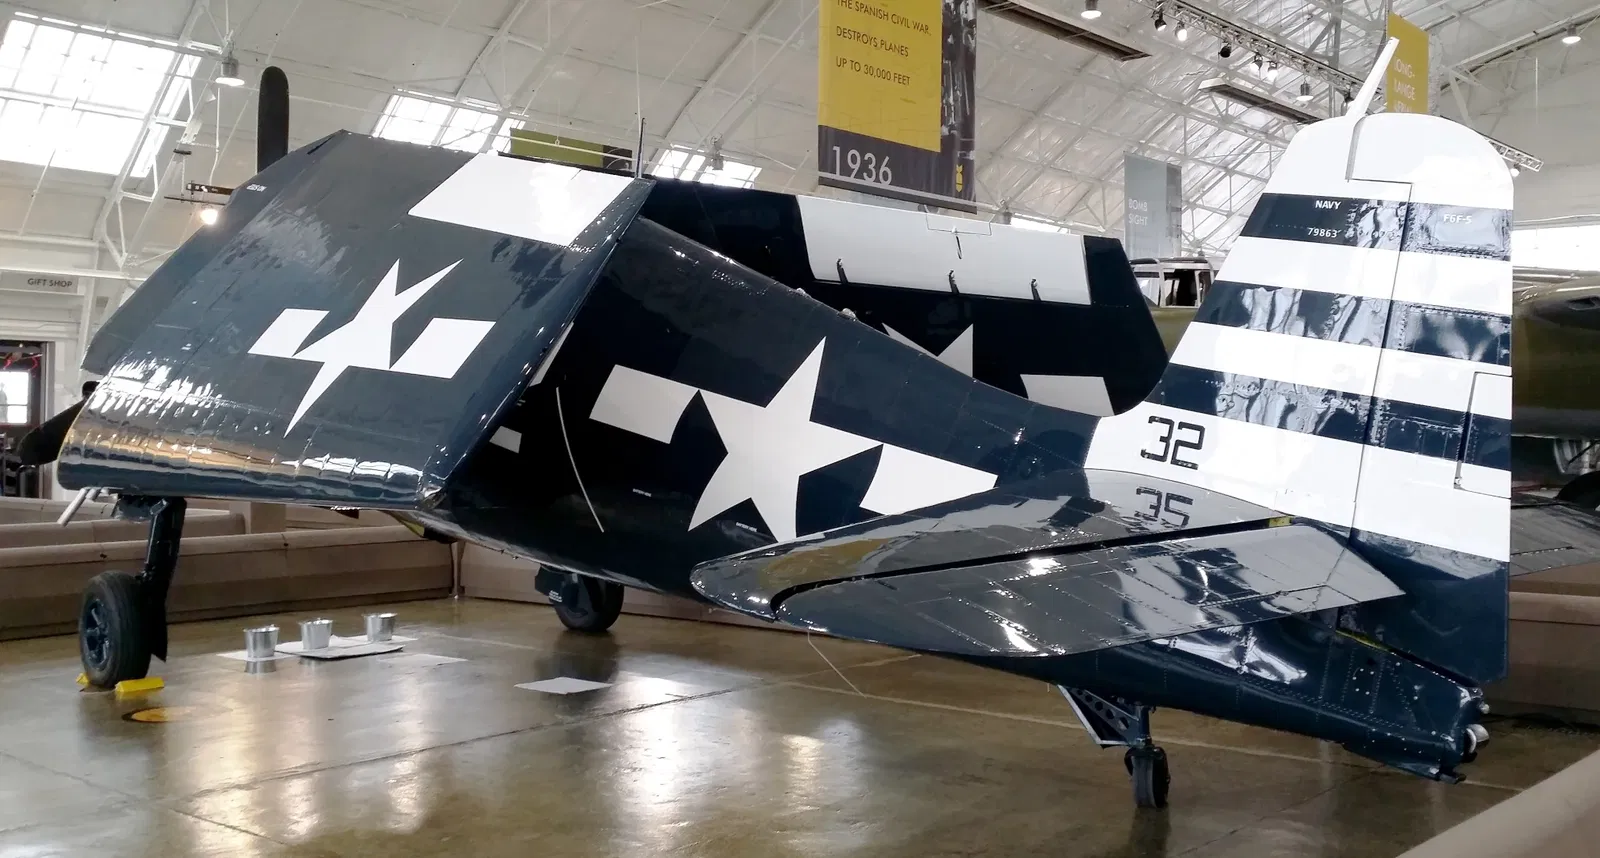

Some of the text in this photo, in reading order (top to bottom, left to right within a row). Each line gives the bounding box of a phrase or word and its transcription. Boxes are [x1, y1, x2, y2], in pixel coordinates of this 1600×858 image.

[837, 0, 853, 10] THE
[854, 1, 889, 21] SPANISH
[891, 13, 910, 29] CIVIL
[836, 26, 909, 57] DESTROYS PLANES
[836, 56, 911, 86] UP TO 30,000 FEET
[832, 145, 893, 186] 1936
[1128, 198, 1148, 211] BOMB
[1315, 200, 1341, 210] NAVY
[1128, 213, 1148, 226] SIGHT
[1307, 227, 1338, 238] 79863
[27, 278, 73, 288] GIFT SHOP
[1140, 415, 1206, 471] 32
